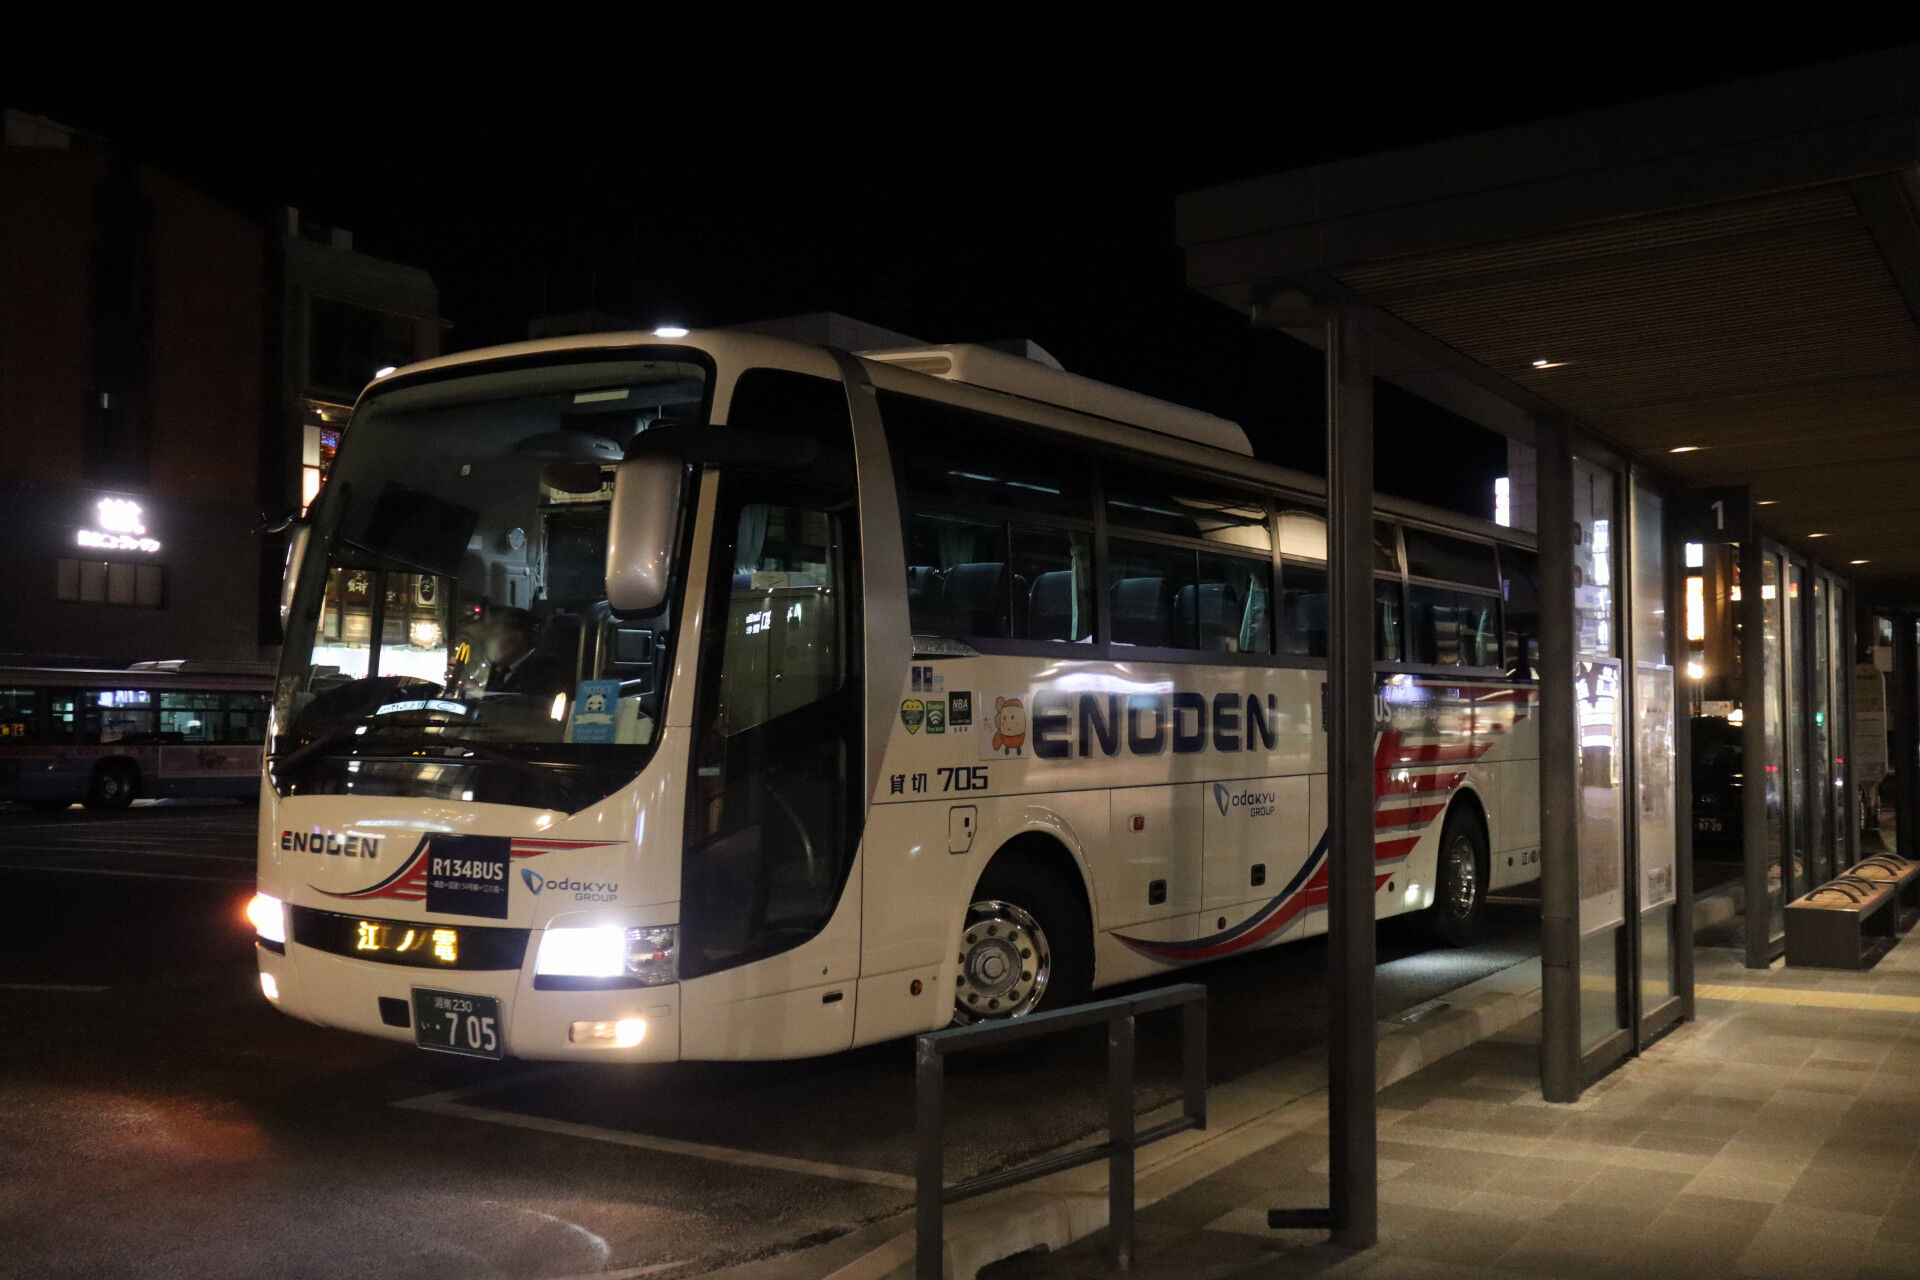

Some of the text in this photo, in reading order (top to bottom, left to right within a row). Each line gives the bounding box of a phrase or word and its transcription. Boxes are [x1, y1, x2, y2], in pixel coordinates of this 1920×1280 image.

[1711, 500, 1724, 530] 1
[952, 698, 969, 712] NBA
[1032, 690, 1278, 759] ENODEN
[890, 766, 988, 795] 貸切 705
[1250, 805, 1275, 817] GROUP
[281, 830, 379, 859] ENODEN
[432, 857, 504, 881] R134BUS
[575, 892, 618, 903] GROUP
[357, 920, 459, 963] 江ノ電
